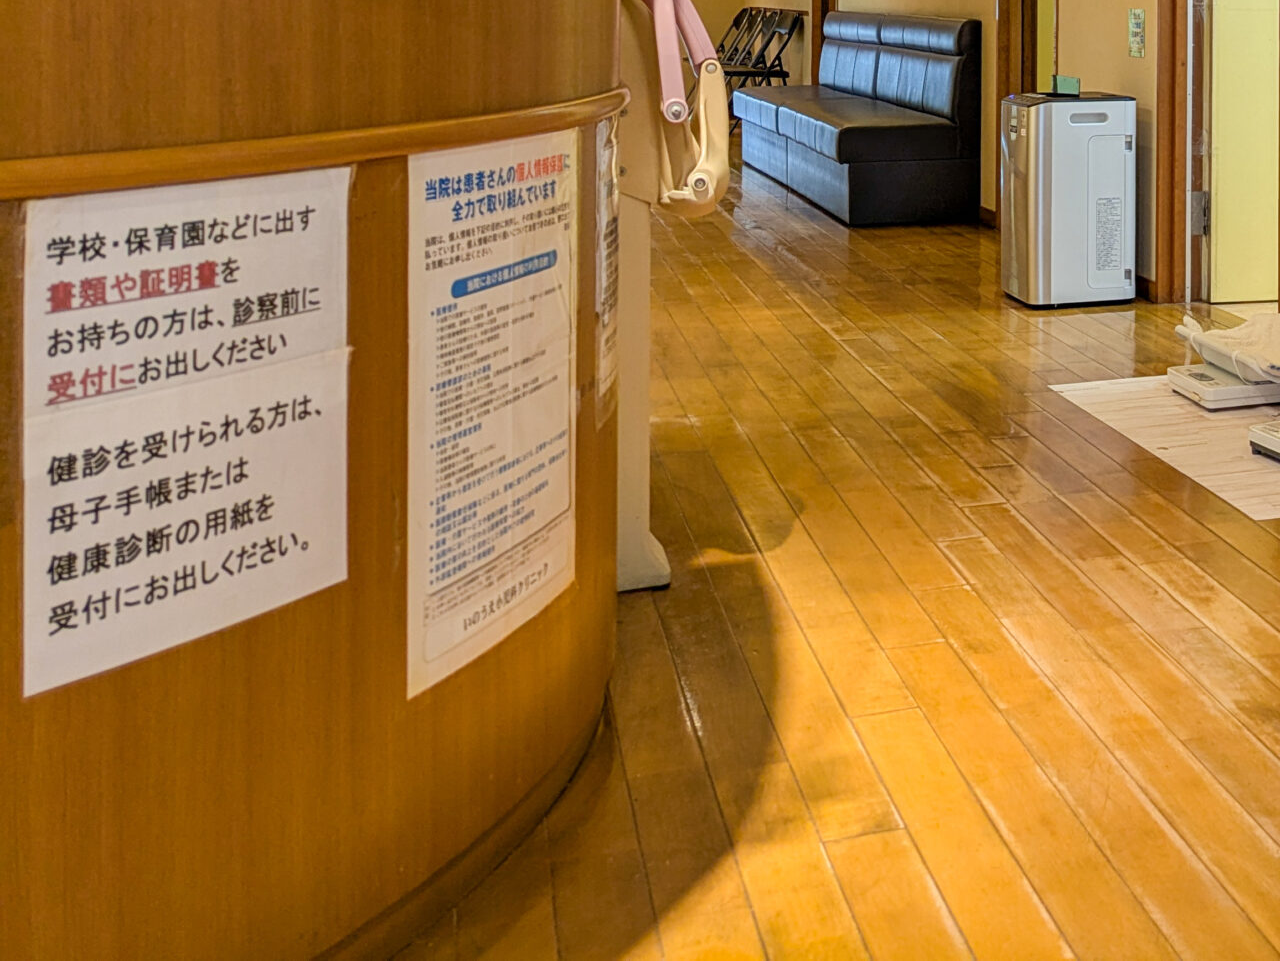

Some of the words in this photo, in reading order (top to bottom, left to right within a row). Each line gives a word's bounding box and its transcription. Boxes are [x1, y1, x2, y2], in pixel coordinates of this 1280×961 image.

[46, 205, 316, 265] 学校・保育園などに出す
[452, 180, 557, 222] 全力で取り組んでいます
[46, 257, 241, 313] 書類や証明書を
[47, 287, 321, 358] お持ちの方は、診察前に
[46, 333, 287, 405] 受付にお出しください
[46, 395, 322, 486] 健診を受けられる方は、
[47, 456, 249, 535] 母子手帳または
[46, 494, 275, 586] 健康診断の用紙を
[48, 533, 309, 637] 受付にお出しください。
